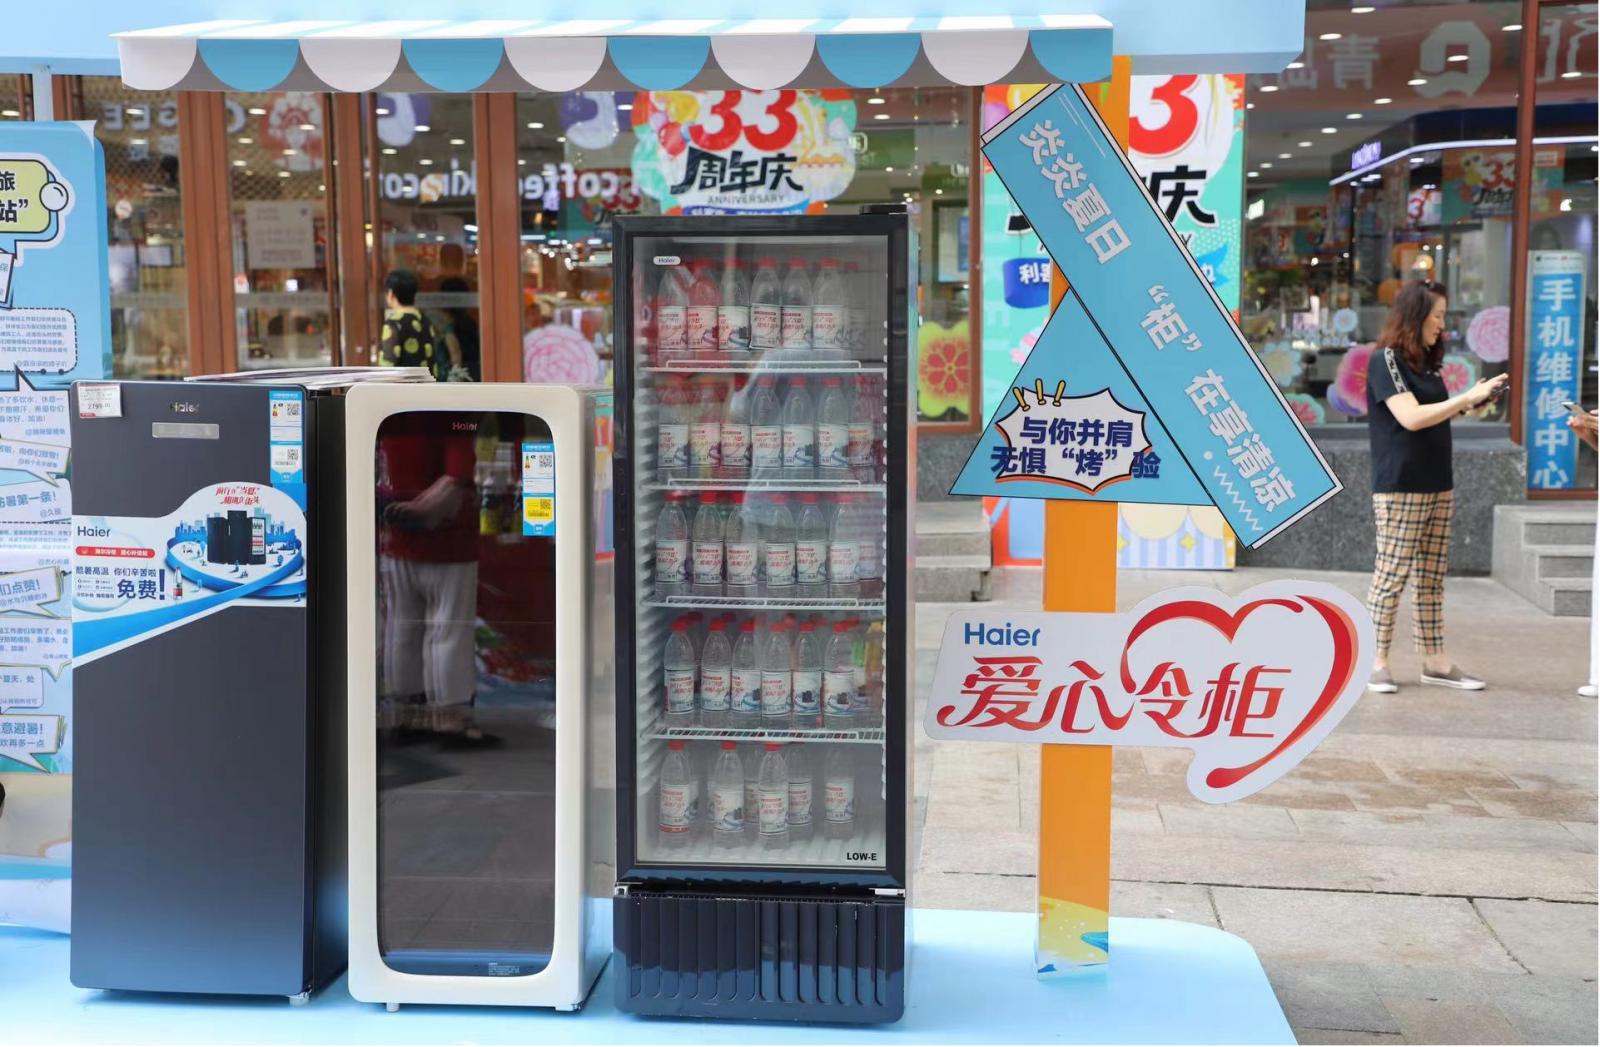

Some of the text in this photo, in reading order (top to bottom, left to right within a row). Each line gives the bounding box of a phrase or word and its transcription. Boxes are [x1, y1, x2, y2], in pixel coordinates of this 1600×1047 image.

[688, 90, 798, 151] 33
[670, 146, 803, 194] 周年庆
[707, 194, 785, 205] ANNIVERSARY
[1532, 278, 1576, 490] 手机维修中心
[452, 422, 478, 431] Haier
[1019, 416, 1134, 449] 与你并肩
[77, 525, 111, 537] Haier
[964, 622, 1041, 647] Haier
[936, 655, 1293, 739] 爱心冷柜
[846, 852, 878, 862] LOW-E
